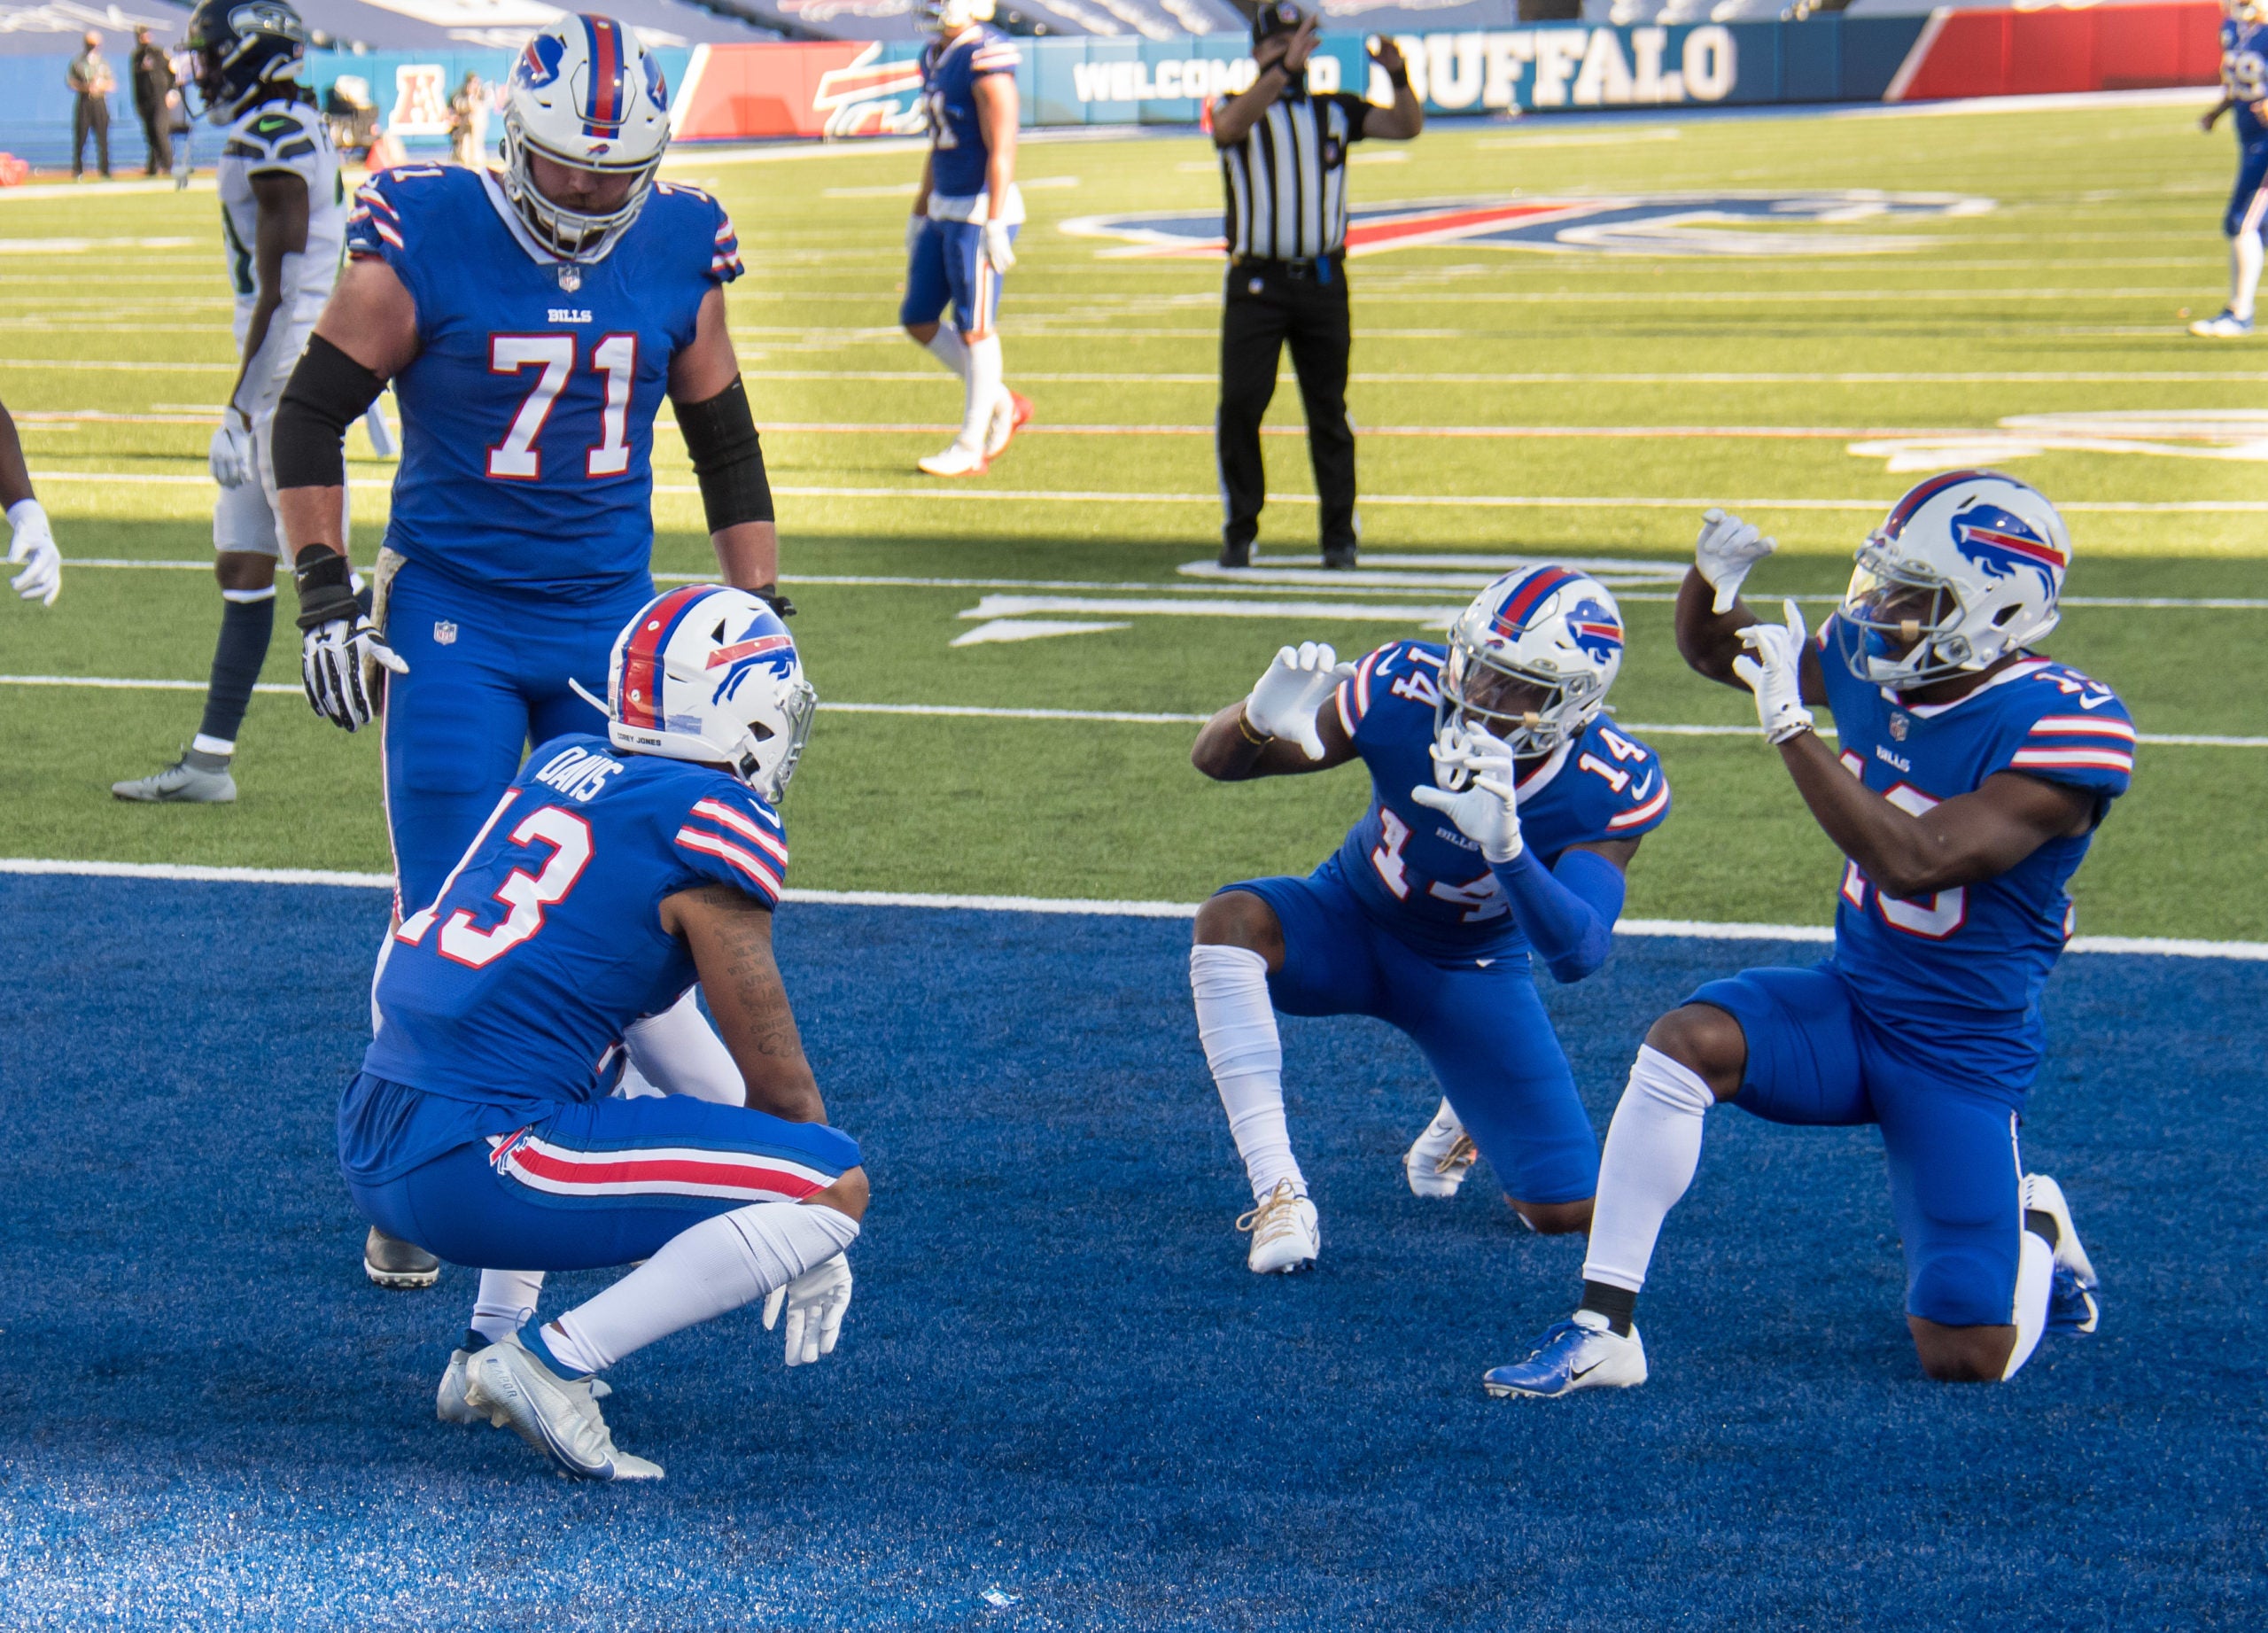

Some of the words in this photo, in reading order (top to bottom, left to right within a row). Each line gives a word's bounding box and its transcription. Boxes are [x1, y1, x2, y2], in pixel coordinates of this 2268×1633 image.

[1073, 58, 1260, 103] WELCOM
[547, 308, 593, 323] BILLS
[485, 331, 639, 482] 71
[1388, 644, 1448, 710] 14
[636, 736, 662, 747] JONES
[1578, 725, 1651, 795] 14
[1875, 744, 1912, 774] BILLS
[535, 744, 625, 803] DAVIS
[1370, 804, 1511, 924] 14
[1434, 825, 1480, 852] BILLS
[393, 786, 596, 971] 13
